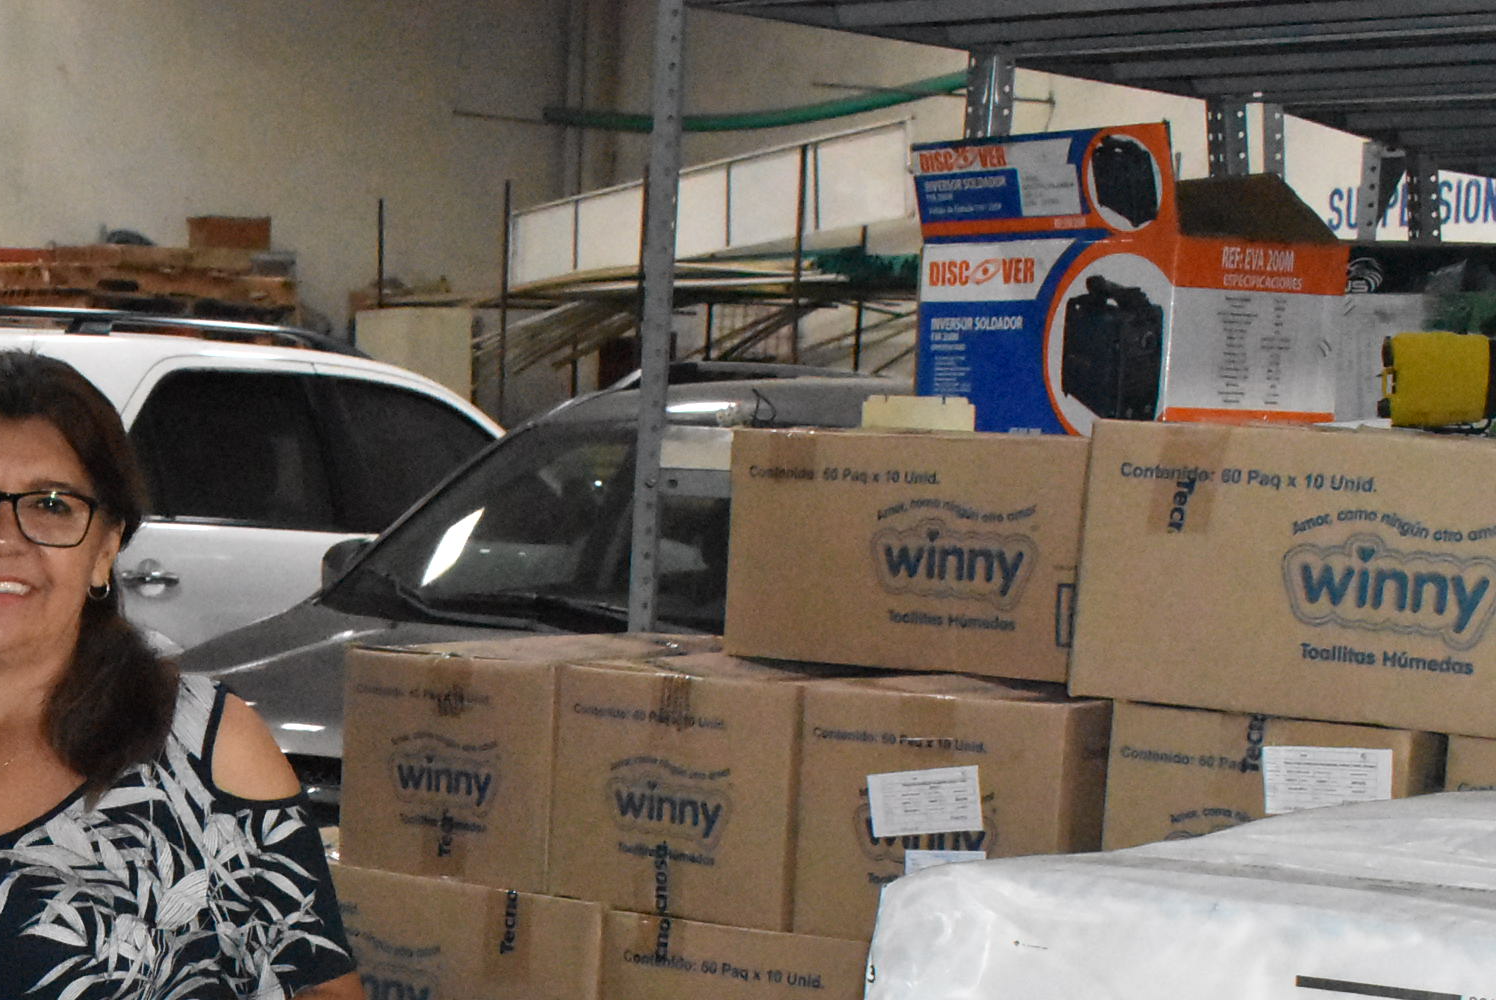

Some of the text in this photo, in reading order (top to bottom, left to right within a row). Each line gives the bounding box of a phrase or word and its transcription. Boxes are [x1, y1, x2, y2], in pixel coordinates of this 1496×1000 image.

[974, 316, 1023, 330] SOLDADOR
[1221, 470, 1242, 484] 60
[1247, 470, 1281, 490] Paq
[1288, 477, 1297, 488] x
[1304, 473, 1324, 489] 10
[1331, 474, 1377, 493] Unid.
[1381, 512, 1428, 539] ningún
[1433, 528, 1463, 543] otro
[884, 531, 1025, 597] winny
[1301, 547, 1490, 634] winny
[889, 610, 943, 626] Toallitas
[1300, 642, 1473, 675] Toallitas Húmedas
[397, 756, 492, 807] winny
[615, 781, 723, 838] winny
[722, 961, 748, 982] Paq
